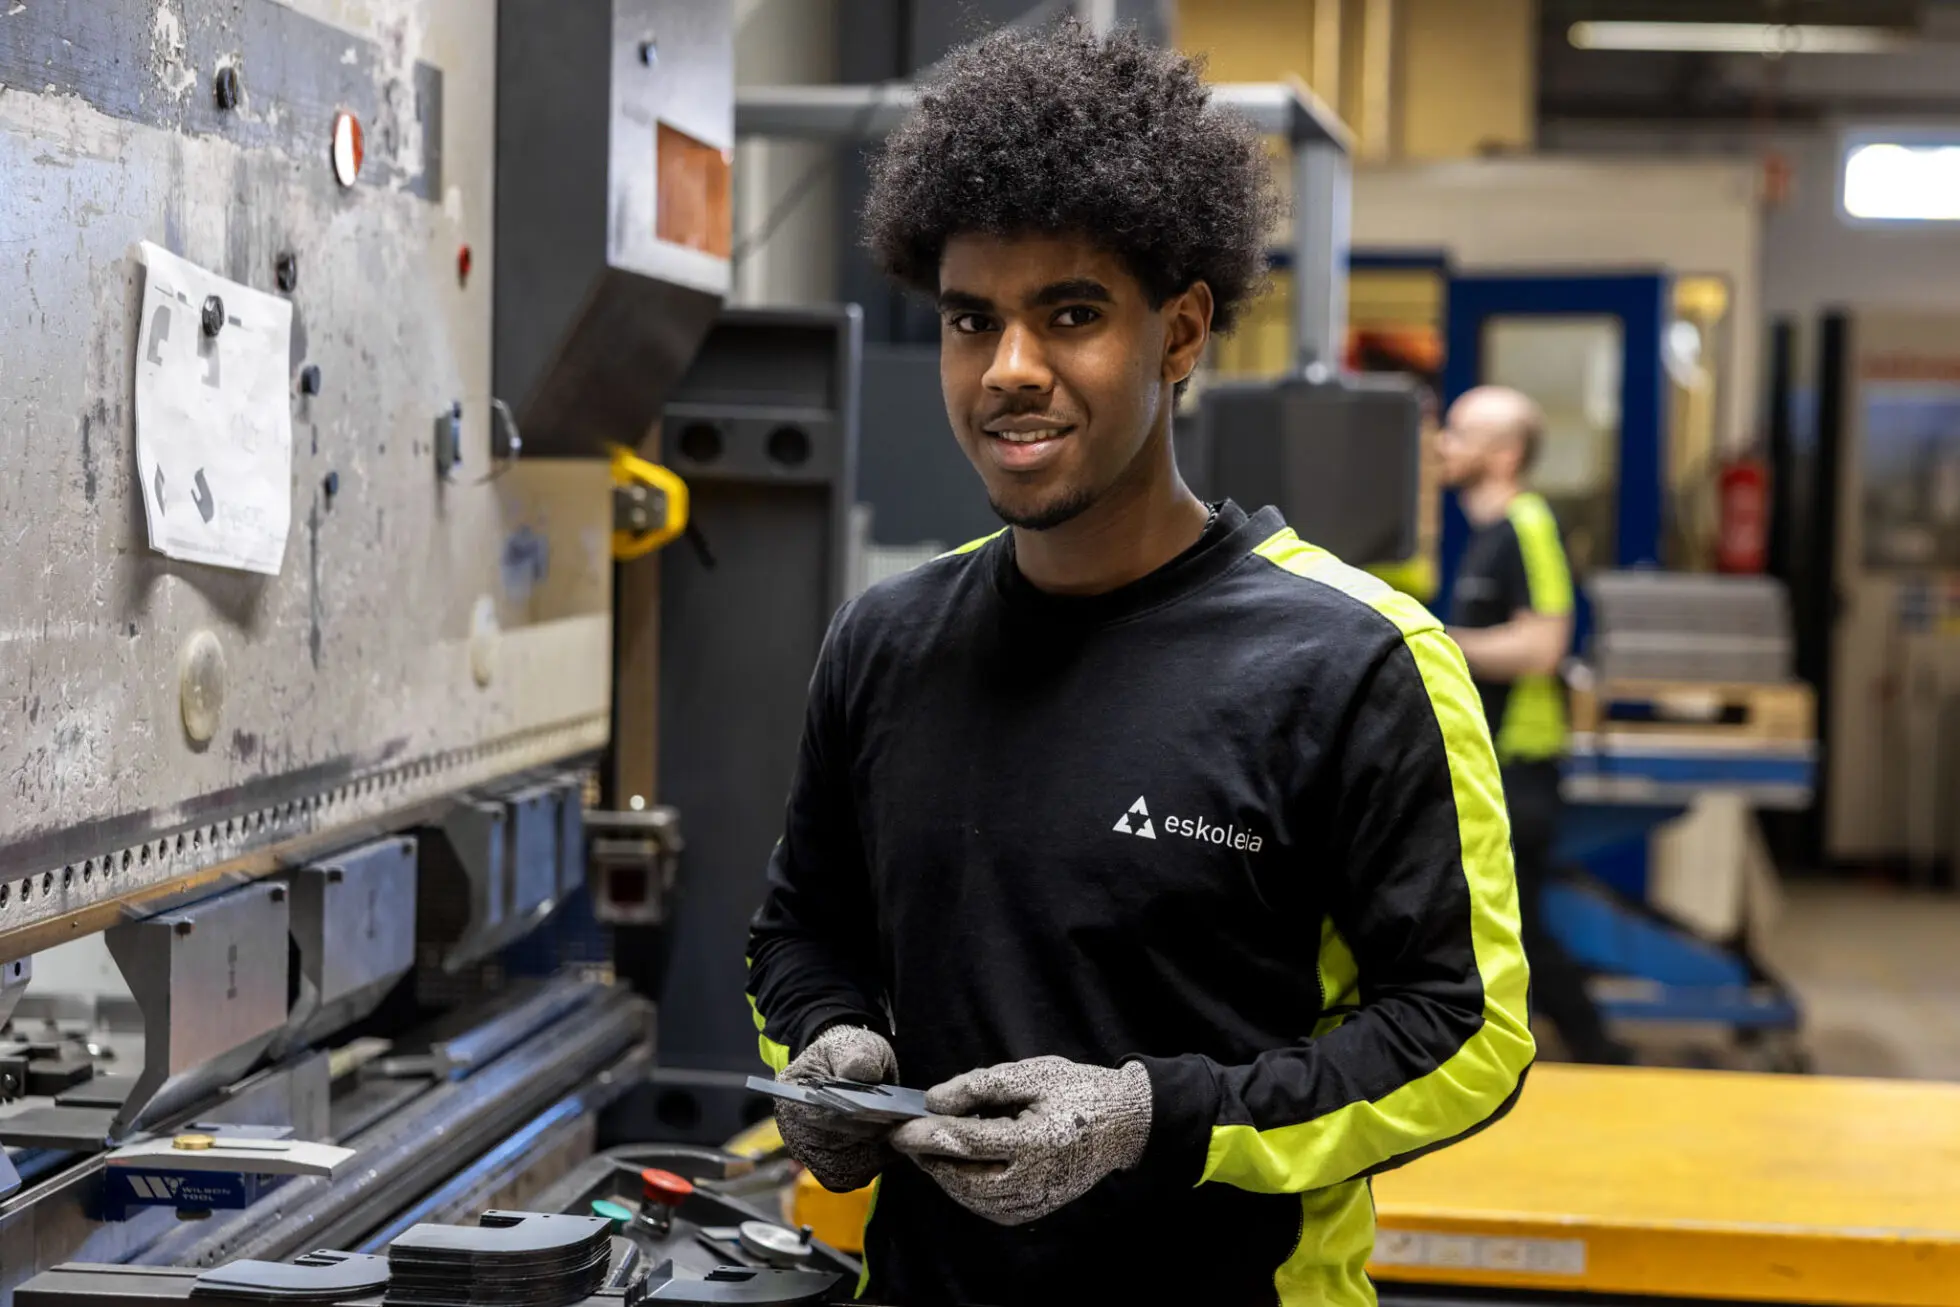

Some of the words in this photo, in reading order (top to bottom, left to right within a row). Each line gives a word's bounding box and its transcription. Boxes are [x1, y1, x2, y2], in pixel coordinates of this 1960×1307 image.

[1164, 815, 1263, 852] eskoleia
[181, 1186, 231, 1195] WILSON
[182, 1193, 215, 1201] TOOL
